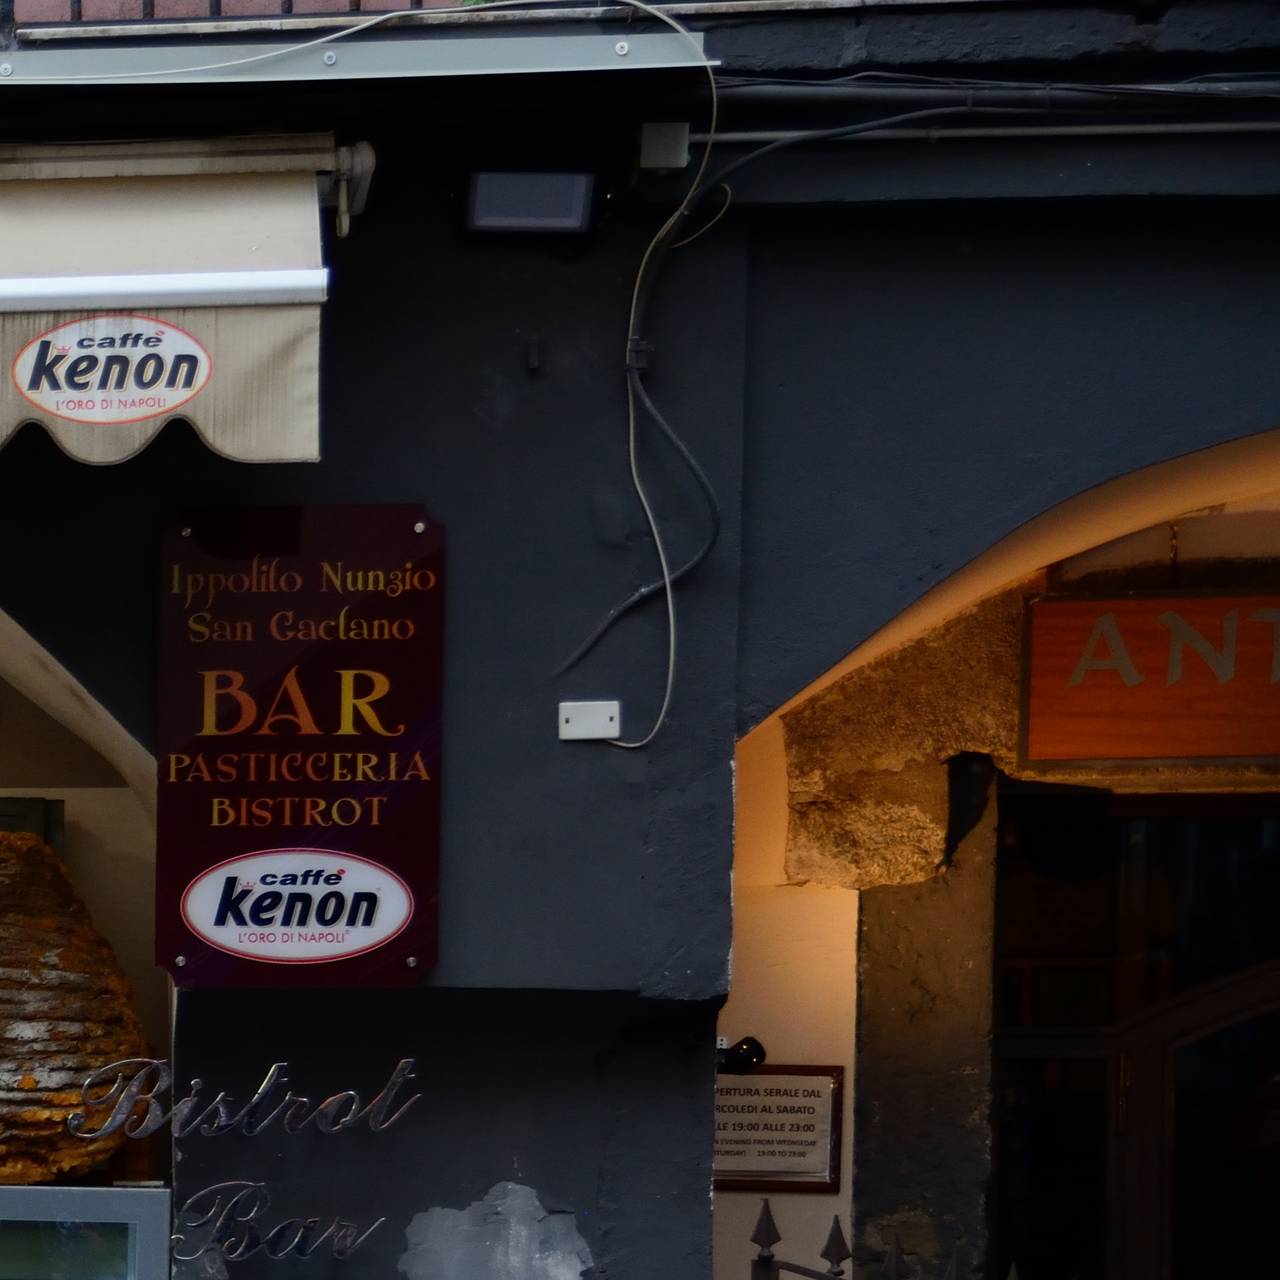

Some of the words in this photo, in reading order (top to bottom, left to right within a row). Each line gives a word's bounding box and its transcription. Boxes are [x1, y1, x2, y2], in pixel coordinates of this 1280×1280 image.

[27, 340, 199, 392] kenon
[56, 400, 95, 411] L'ORO
[101, 399, 112, 410] DI
[118, 397, 166, 410] NAPOLI
[171, 554, 302, 609] Ippolito
[322, 562, 437, 598] Nunzio
[188, 612, 253, 643] San
[270, 607, 415, 641] Gaetano
[196, 666, 405, 737] BAR
[168, 752, 431, 783] PASTICCERIA
[210, 797, 387, 828] BISTROT
[214, 877, 379, 928] kenon
[239, 932, 276, 943] L'ORO
[282, 932, 293, 943] DI
[298, 932, 344, 943] NAPOLI
[67, 1058, 422, 1139] Bistrot
[715, 1088, 760, 1097] ERTURA
[763, 1089, 800, 1098] SERALE
[802, 1089, 822, 1098] DAL
[715, 1105, 758, 1114] RCOLEDI
[760, 1105, 773, 1114] AL
[776, 1105, 815, 1115] SABATO
[732, 1123, 759, 1132] 19:00
[762, 1123, 785, 1132] ALLE
[788, 1124, 815, 1132] 23:00
[171, 1181, 387, 1261] Bar
